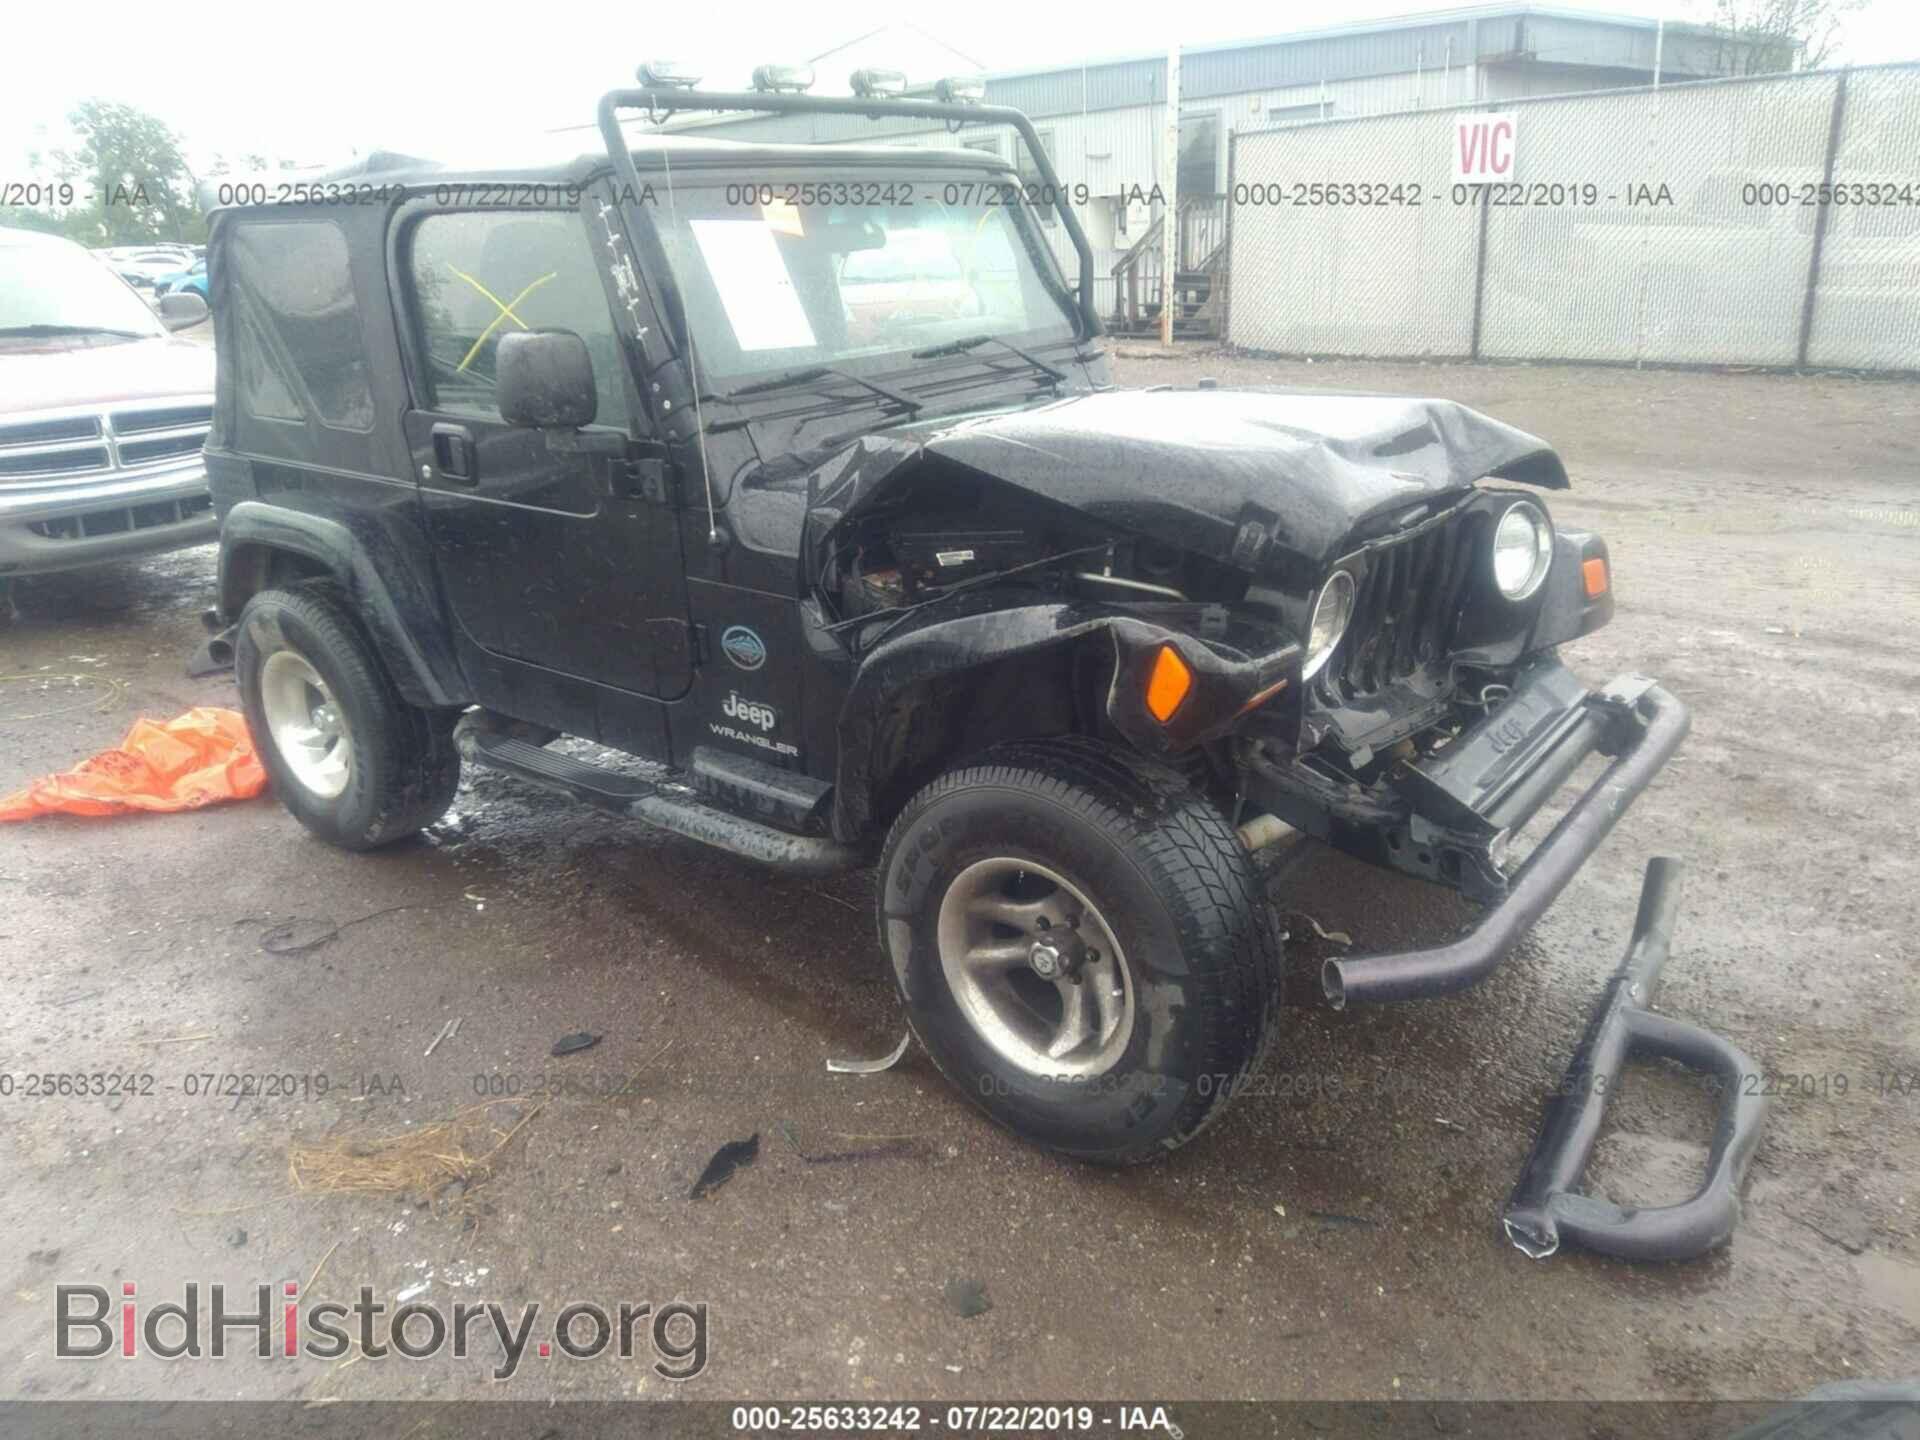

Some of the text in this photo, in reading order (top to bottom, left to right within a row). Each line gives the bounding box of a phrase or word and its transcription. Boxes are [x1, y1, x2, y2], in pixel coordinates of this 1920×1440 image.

[1459, 121, 1511, 174] VIC
[723, 692, 775, 731] Jeep
[709, 722, 799, 757] WRANGLER
